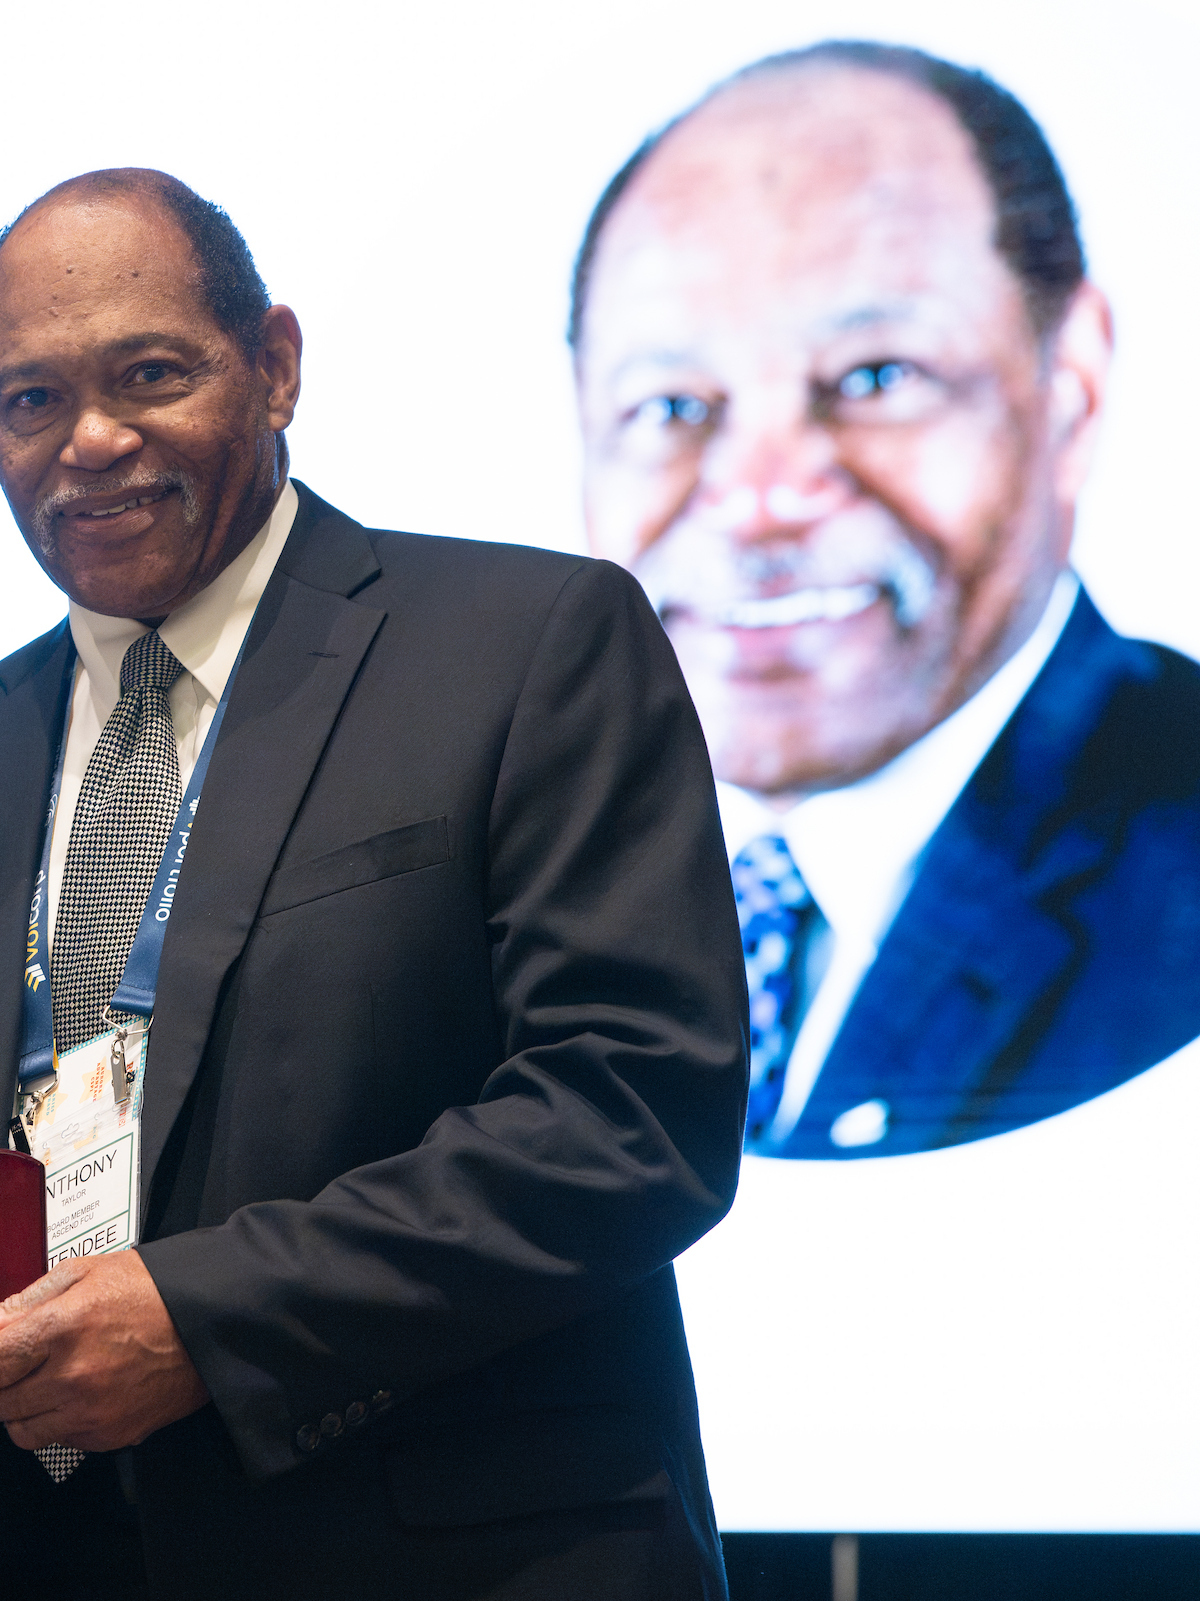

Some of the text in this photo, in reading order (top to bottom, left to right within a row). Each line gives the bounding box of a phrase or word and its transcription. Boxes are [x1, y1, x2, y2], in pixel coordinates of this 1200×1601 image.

[46, 1149, 117, 1199] NTHONY
[61, 1188, 87, 1207] TAYLOR
[47, 1200, 100, 1234] BOARD MEMBER
[52, 1212, 94, 1240] ASCEND FCU
[48, 1224, 117, 1269] TENDEE
